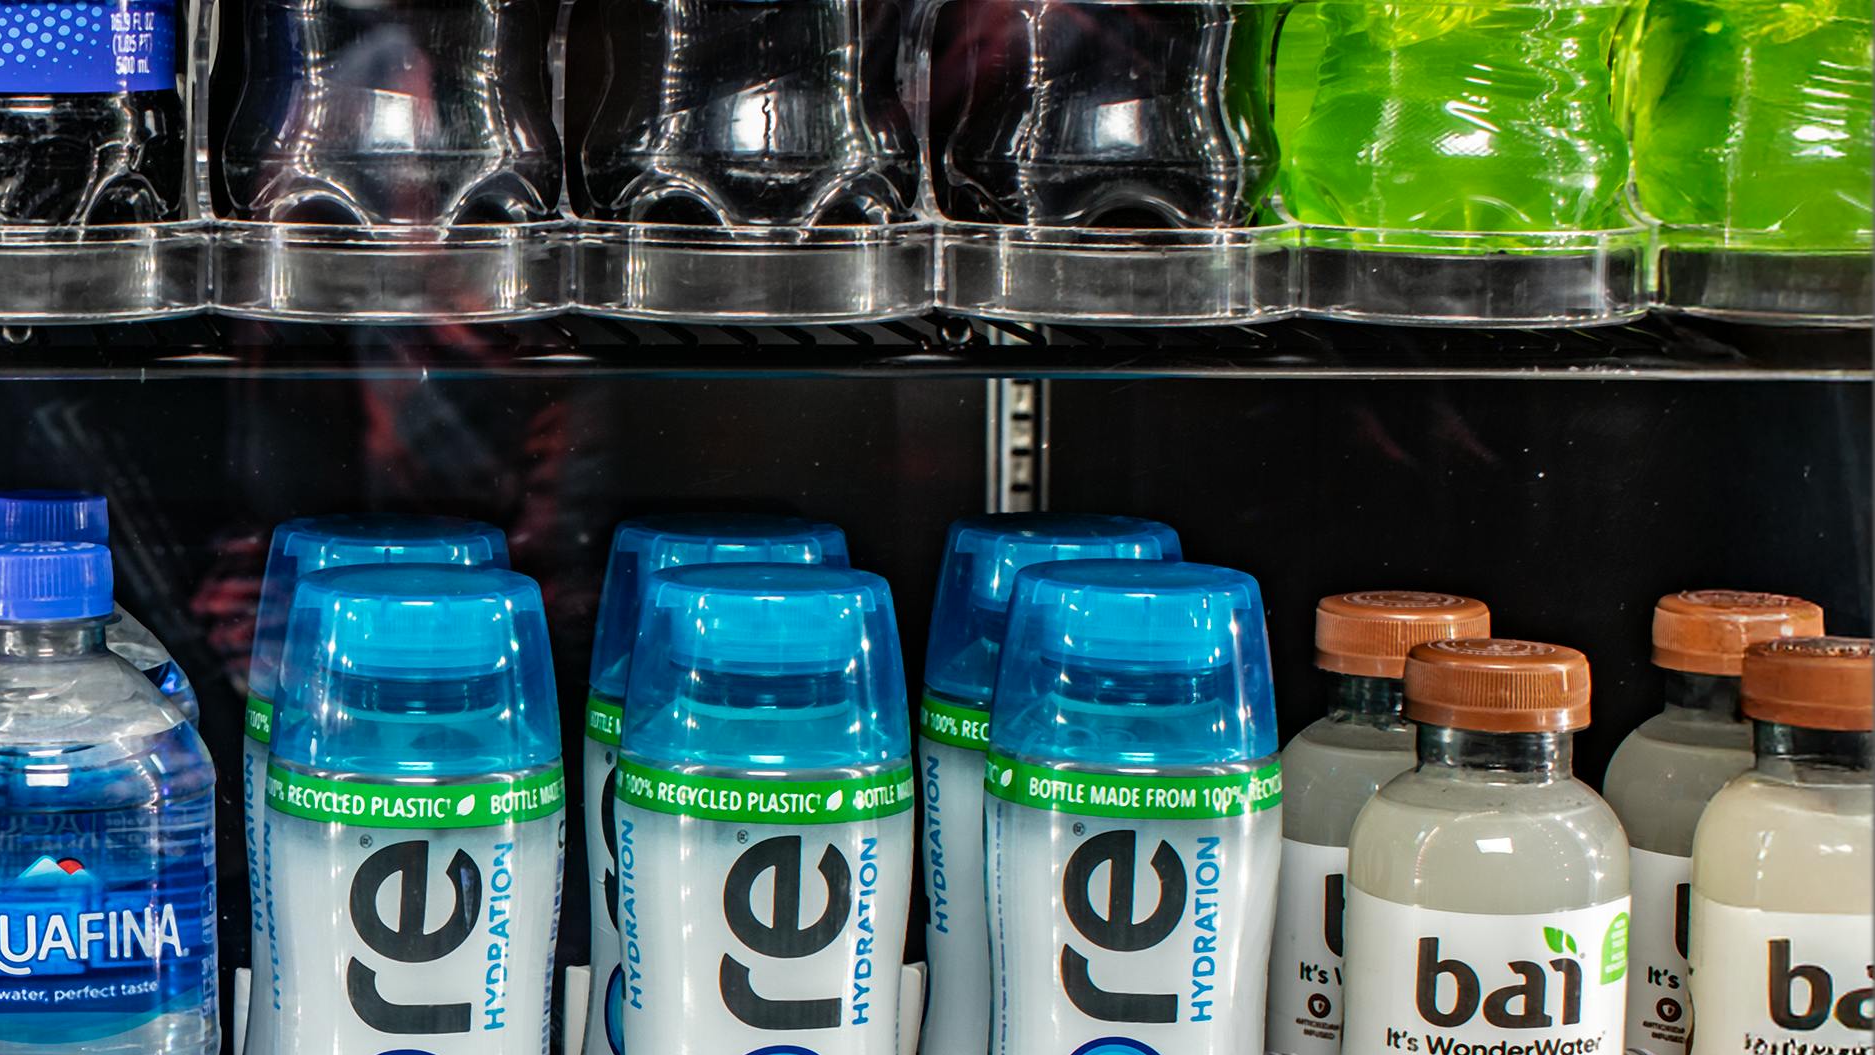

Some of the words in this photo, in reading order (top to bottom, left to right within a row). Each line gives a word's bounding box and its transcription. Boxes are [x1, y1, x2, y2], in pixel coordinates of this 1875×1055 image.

[287, 785, 365, 815] RECYCLED
[490, 790, 537, 815] BOTTLE
[657, 782, 742, 811] RECYCLED
[1029, 777, 1085, 804] BOTTLE
[1090, 785, 1140, 809] MADE
[1145, 787, 1197, 809] FROM
[1202, 786, 1244, 812] 100%
[926, 755, 948, 934] HYDRATION
[621, 819, 643, 1010] HYDRATION
[852, 837, 878, 1026] HYDRATION
[1190, 836, 1221, 1023] HYDRATION
[484, 841, 514, 1031] HYDRATION
[1300, 961, 1329, 985] It's
[1416, 927, 1582, 1028] bai
[1647, 966, 1680, 990] It's
[1768, 938, 1875, 1031] ba
[55, 984, 116, 1002] perfect
[121, 980, 159, 995] taste
[1386, 1027, 1419, 1052] It's
